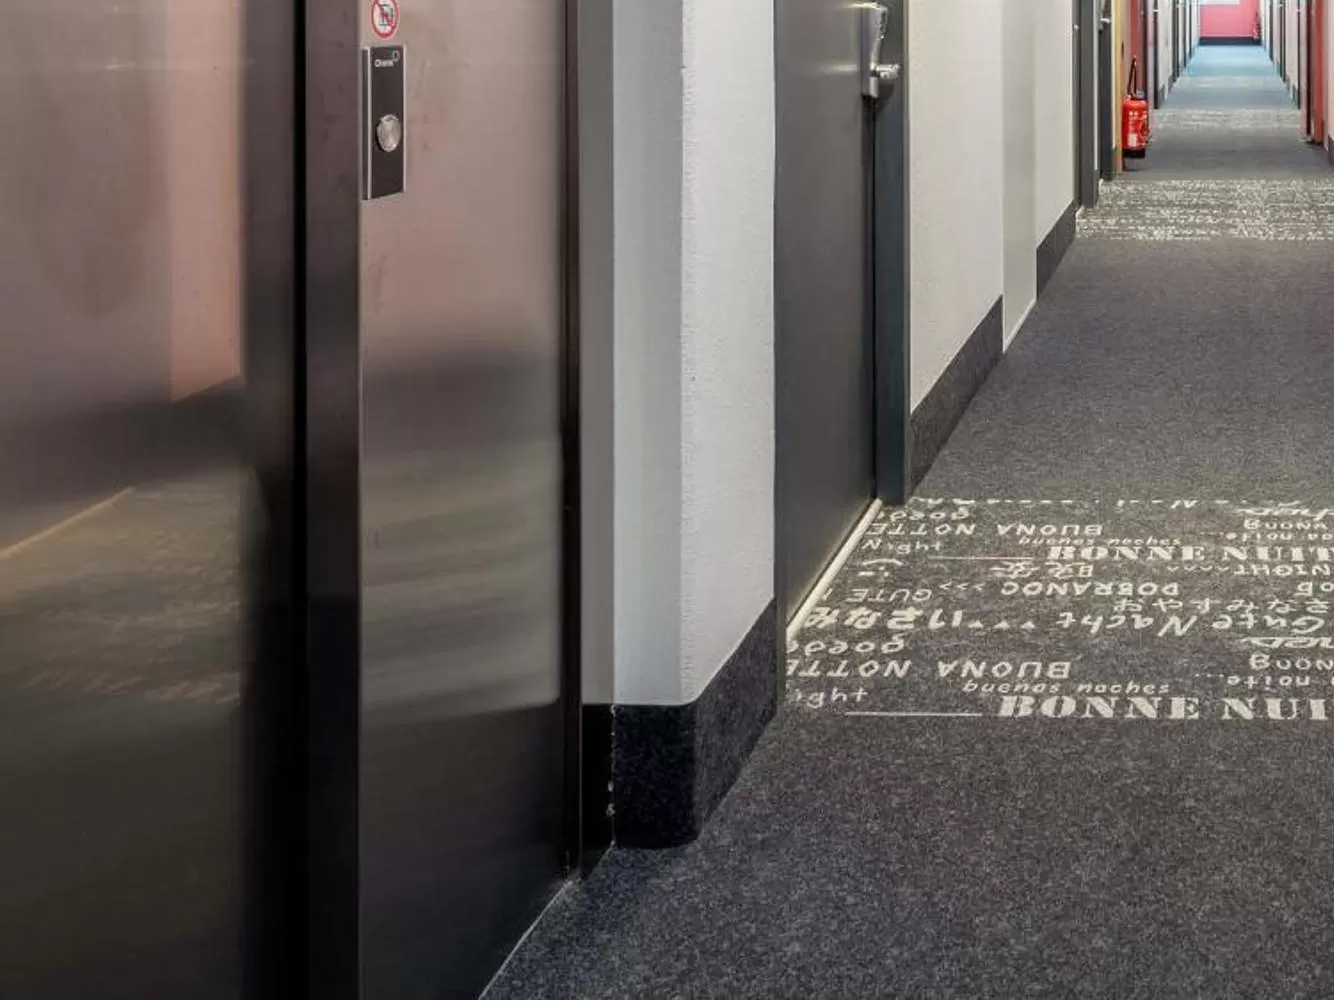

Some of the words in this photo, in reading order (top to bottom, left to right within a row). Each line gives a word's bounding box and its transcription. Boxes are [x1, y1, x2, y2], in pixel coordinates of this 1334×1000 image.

[863, 523, 977, 536] NOTTE
[995, 524, 1104, 537] BUONA
[1046, 546, 1206, 562] BONNE
[845, 588, 933, 603] GUTE
[999, 581, 1180, 597] DOBRANOC
[1056, 611, 1198, 637] Nacht
[1211, 614, 1326, 634] Gute
[937, 660, 1072, 680] BUONA
[962, 680, 1062, 694] buenas
[1076, 680, 1171, 695] noches
[997, 695, 1201, 720] BONNE
